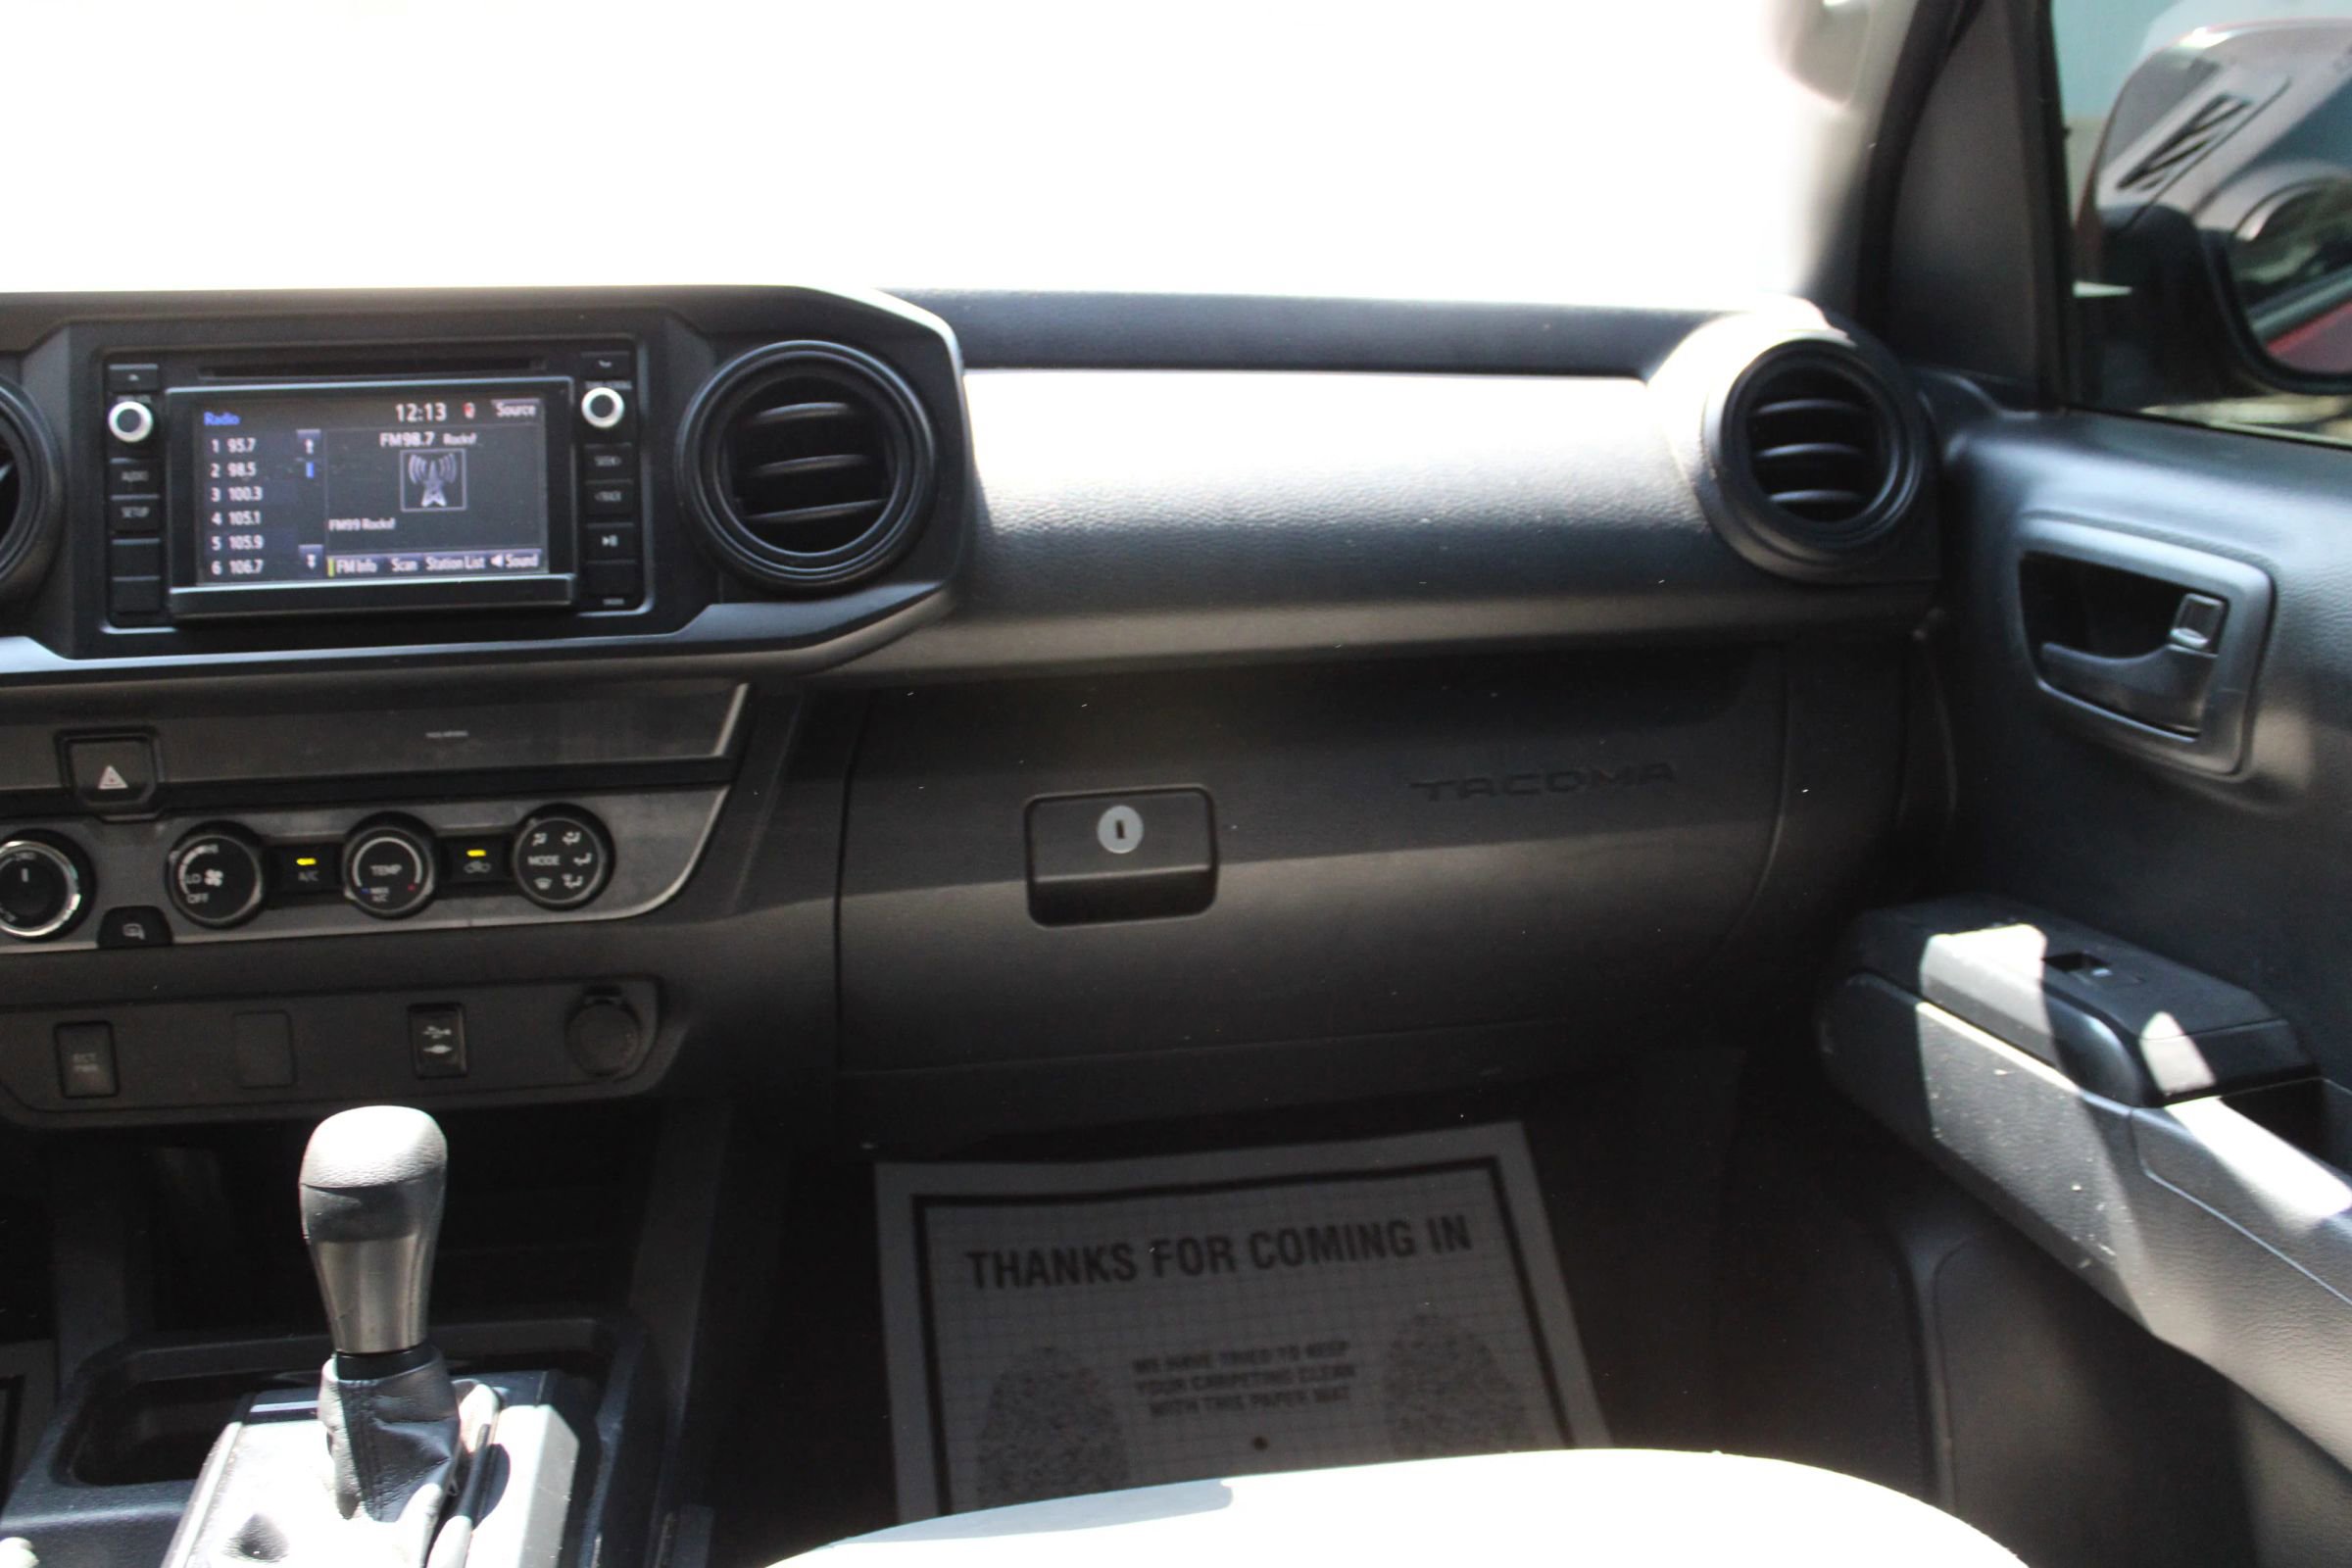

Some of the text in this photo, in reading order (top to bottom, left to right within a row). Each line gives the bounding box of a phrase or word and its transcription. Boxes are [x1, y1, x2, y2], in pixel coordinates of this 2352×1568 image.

[395, 402, 447, 422] 12:13
[496, 403, 536, 417] Source
[204, 412, 241, 426] Radio
[212, 438, 257, 454] 1 95.7
[211, 462, 257, 478] 2 98.5
[211, 486, 264, 503] 3 100.3
[211, 511, 262, 526] 4 105.1
[212, 534, 265, 551] 5 105.9
[212, 559, 265, 575] 6 106.7
[391, 557, 418, 571] Scan
[425, 555, 486, 571] Station List
[505, 553, 539, 567] Sound
[1409, 763, 1677, 802] TACOMA
[527, 855, 561, 866] MODE
[369, 863, 403, 877] TEMP
[187, 893, 209, 904] OFF
[966, 1215, 1472, 1290] THANKS FOR COMING IN
